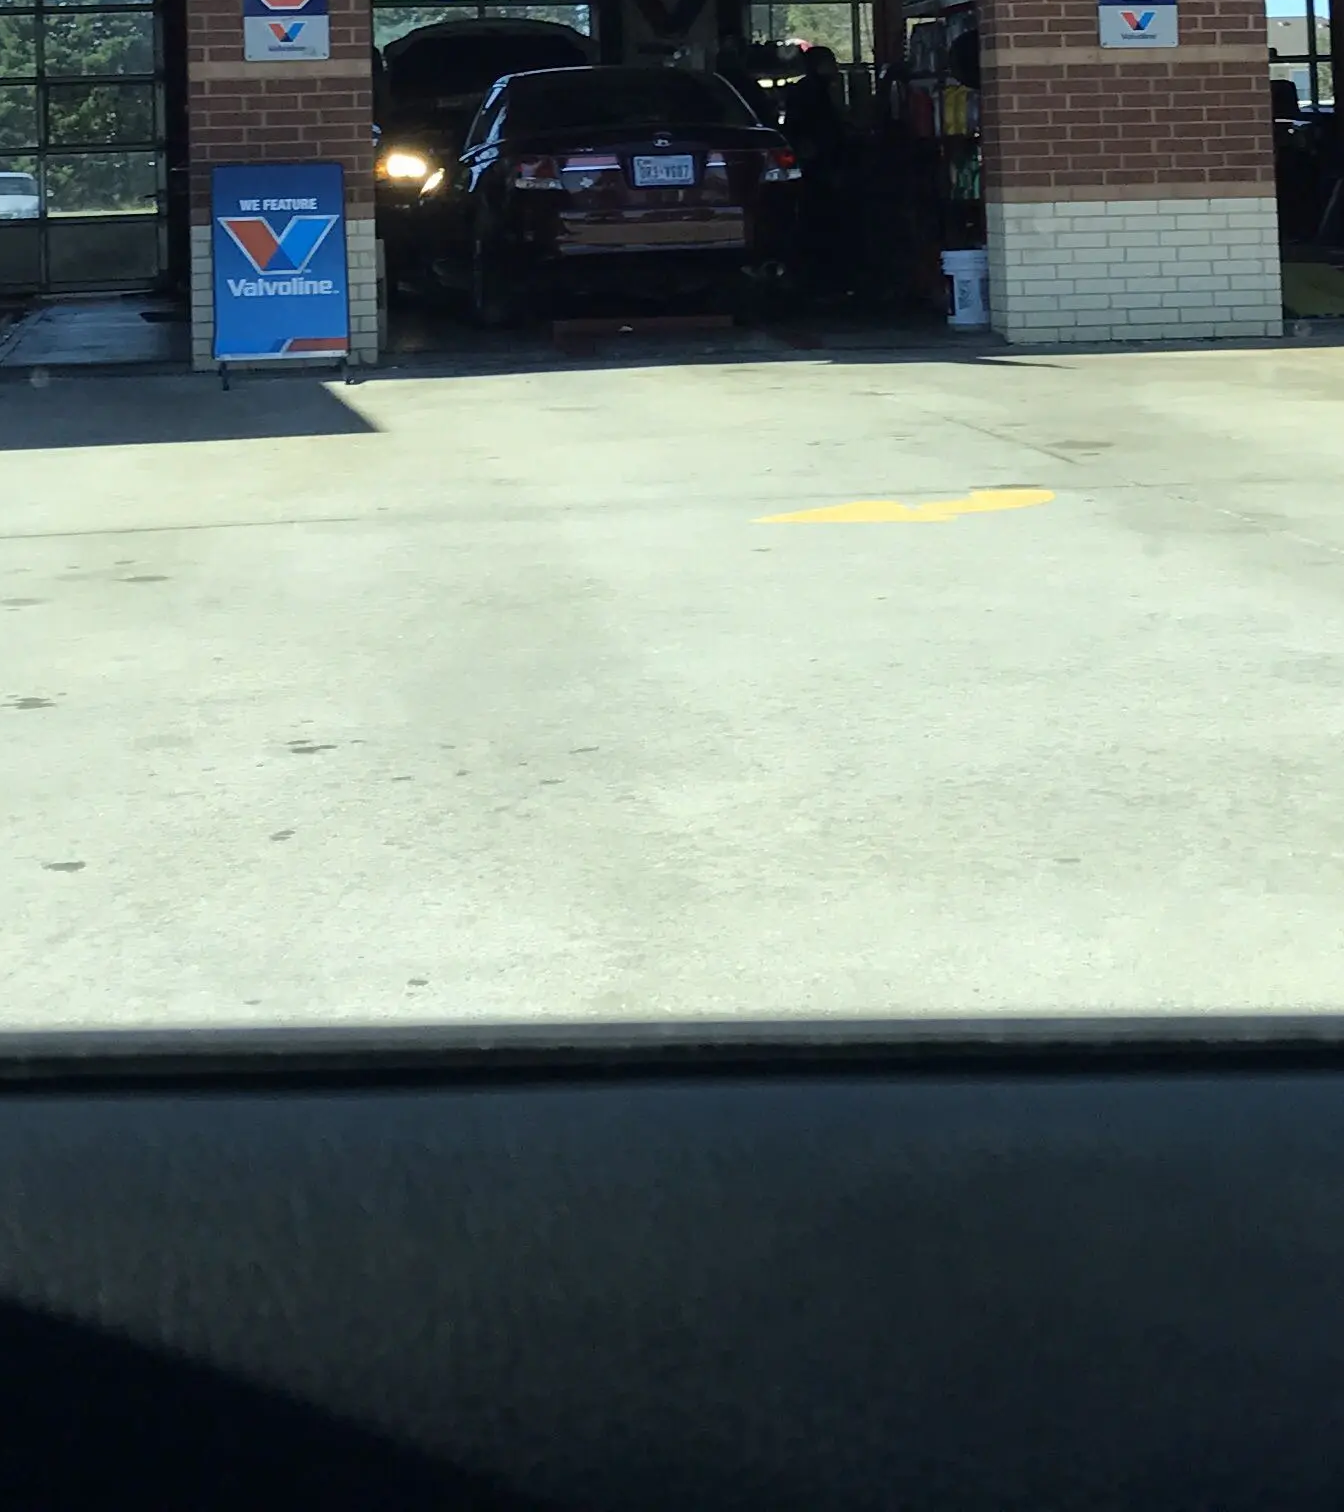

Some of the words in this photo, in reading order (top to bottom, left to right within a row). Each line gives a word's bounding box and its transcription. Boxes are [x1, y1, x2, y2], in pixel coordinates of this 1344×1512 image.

[239, 199, 261, 211] WE
[262, 198, 317, 211] FEATURE
[226, 277, 334, 297] Valvoline
